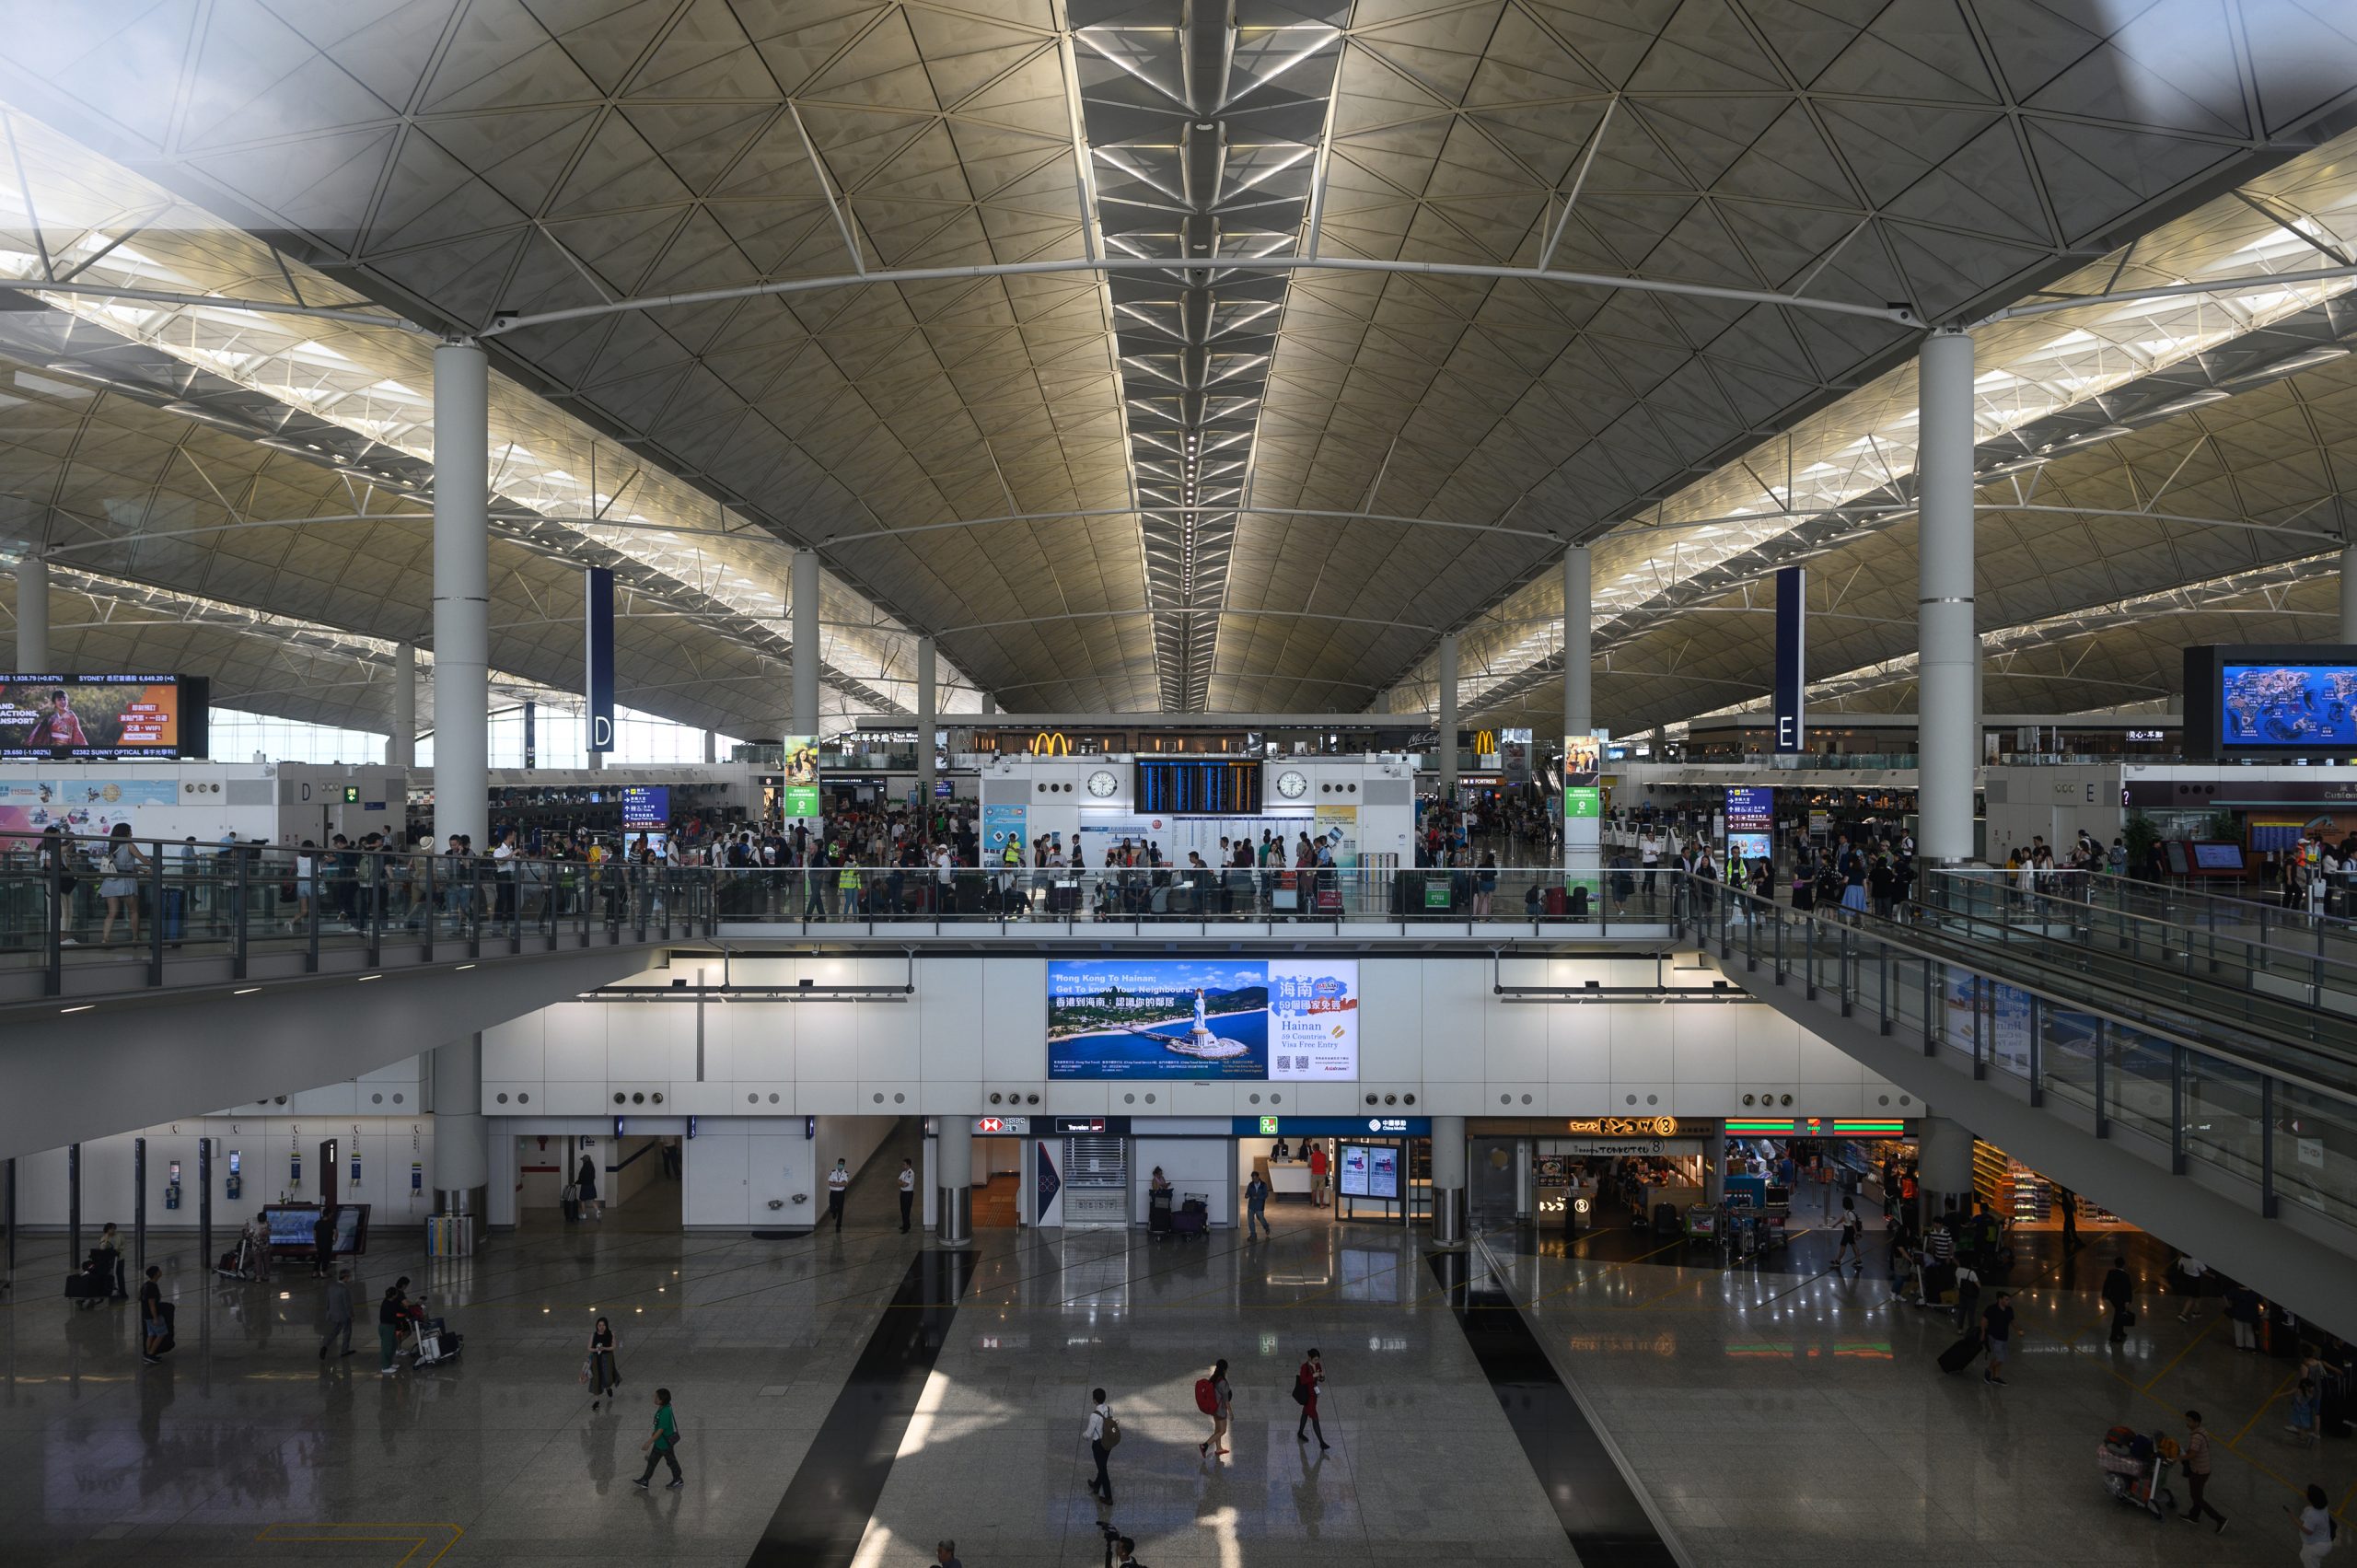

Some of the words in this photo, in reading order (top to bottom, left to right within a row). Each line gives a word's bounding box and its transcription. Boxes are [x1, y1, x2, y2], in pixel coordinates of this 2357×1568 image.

[595, 715, 611, 746] D
[1780, 716, 1793, 747] E
[302, 783, 310, 801] D
[2087, 784, 2095, 803] E
[1056, 974, 1079, 984] Hong
[1082, 974, 1106, 984] Kong
[1109, 974, 1120, 983] To
[1056, 985, 1073, 993] Get
[1074, 985, 1086, 993] To
[1088, 985, 1113, 993] know
[1115, 985, 1136, 993] Your
[1138, 985, 1193, 995] Neighbours.
[1280, 981, 1313, 997] 海南
[1282, 1020, 1322, 1030] Hainan
[1281, 1040, 1297, 1049] Visa
[1299, 1040, 1316, 1049] Free
[1318, 1040, 1339, 1050] Entry
